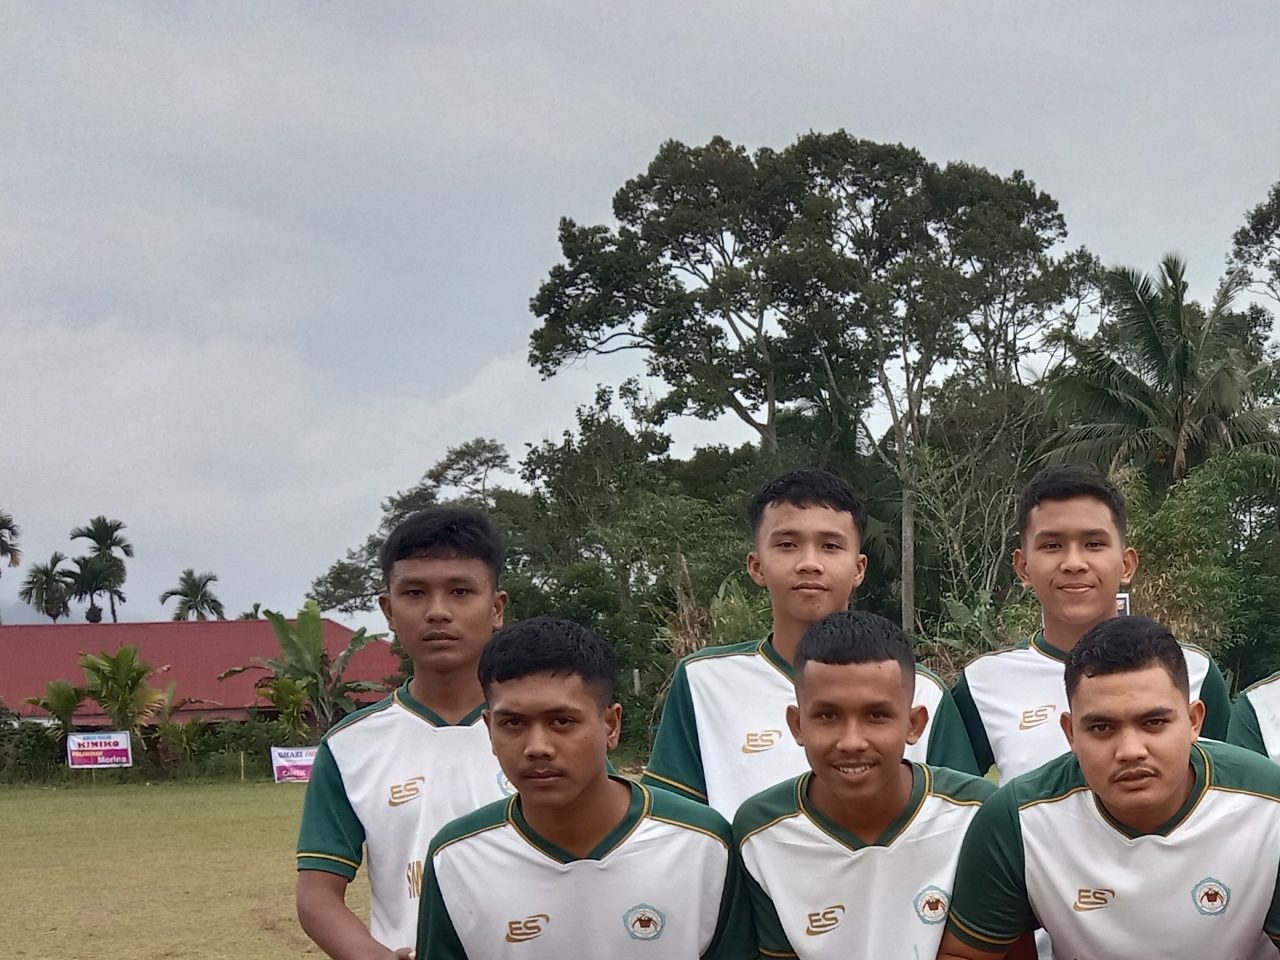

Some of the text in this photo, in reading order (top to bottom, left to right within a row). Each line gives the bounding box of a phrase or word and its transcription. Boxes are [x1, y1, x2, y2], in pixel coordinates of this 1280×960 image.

[1021, 706, 1050, 725] ES
[745, 731, 777, 749] ES
[389, 780, 421, 801] ES
[1076, 888, 1110, 907] ES
[507, 917, 543, 938] ES
[807, 908, 840, 930] ES
